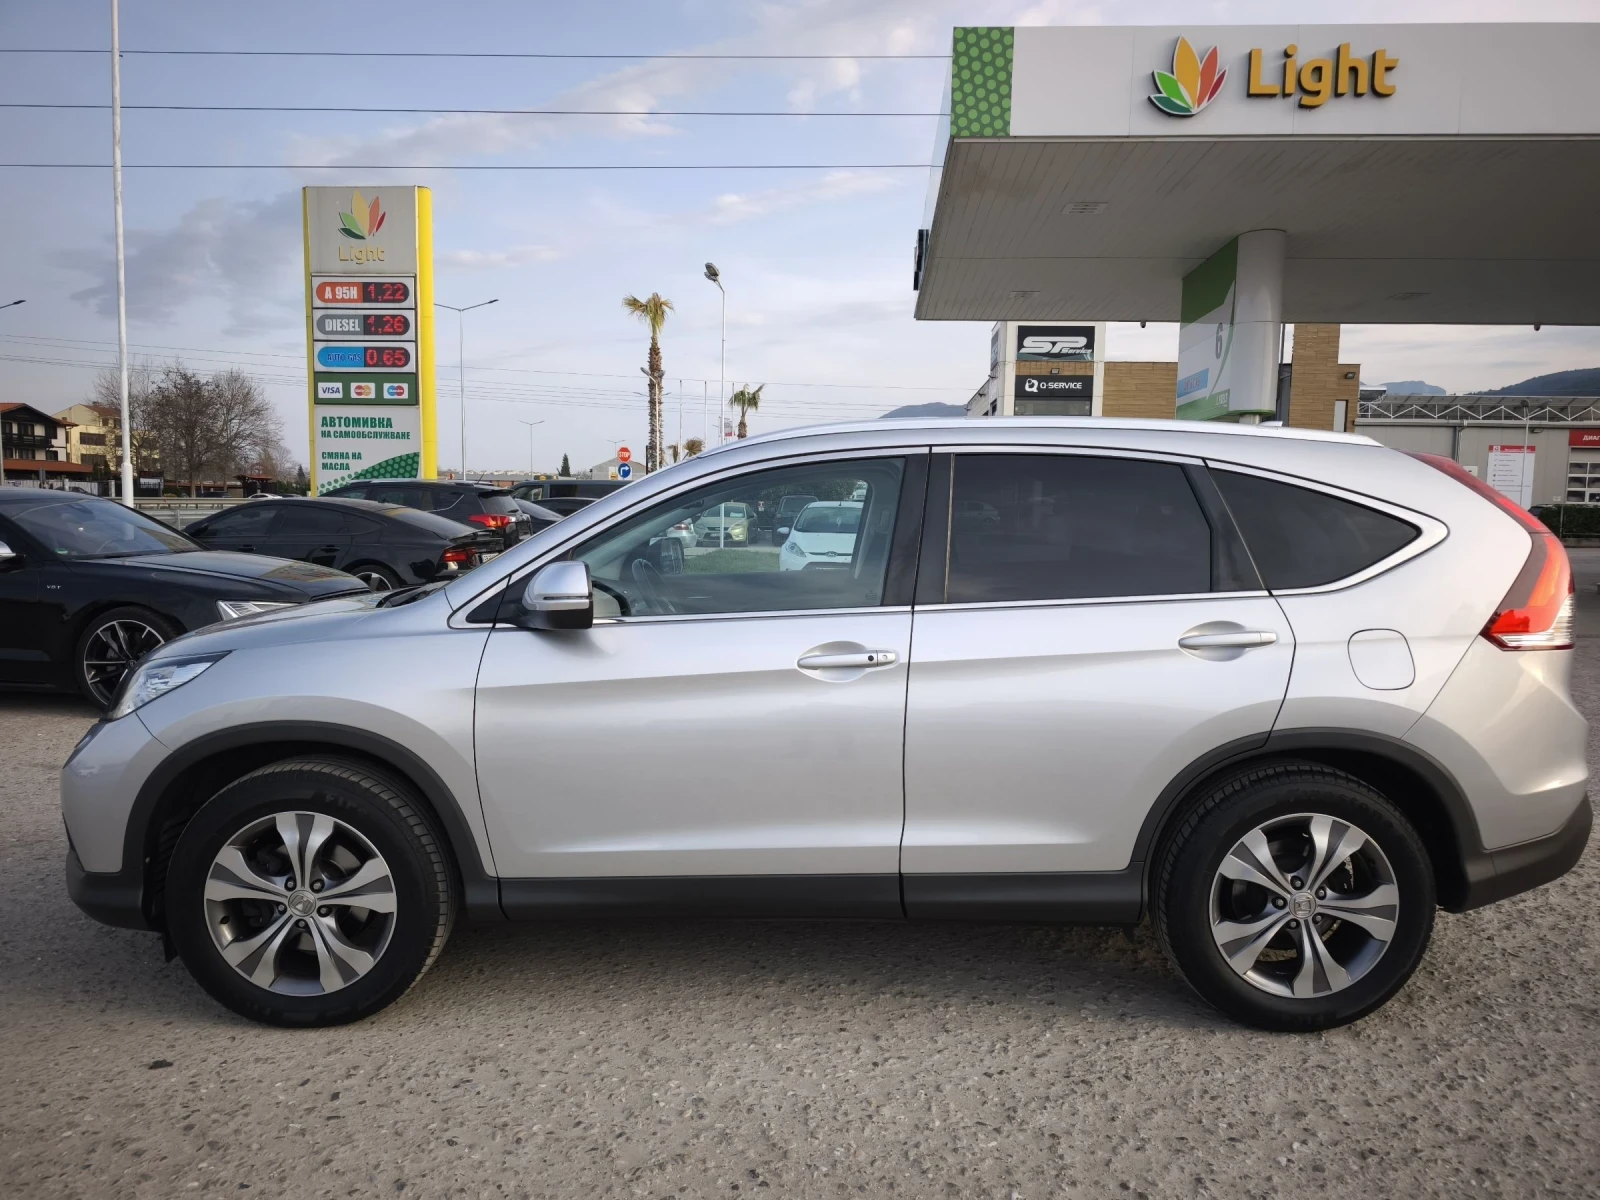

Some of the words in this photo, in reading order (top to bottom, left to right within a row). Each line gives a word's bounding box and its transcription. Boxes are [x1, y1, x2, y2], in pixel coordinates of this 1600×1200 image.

[1247, 42, 1399, 108] Light
[339, 245, 384, 264] Light
[325, 287, 332, 299] A
[325, 319, 360, 331] DIESEL
[1216, 322, 1223, 359] 6
[327, 353, 345, 361] AUTO
[348, 353, 361, 361] GAS
[321, 386, 340, 394] VISA
[321, 416, 393, 428] АВТОМИВКА
[321, 430, 331, 438] НА
[333, 430, 410, 439] САМООБСЛУЖВАНЕ
[321, 451, 350, 460] СМЯНА
[351, 452, 362, 460] НА
[321, 462, 350, 471] МАСЛА
